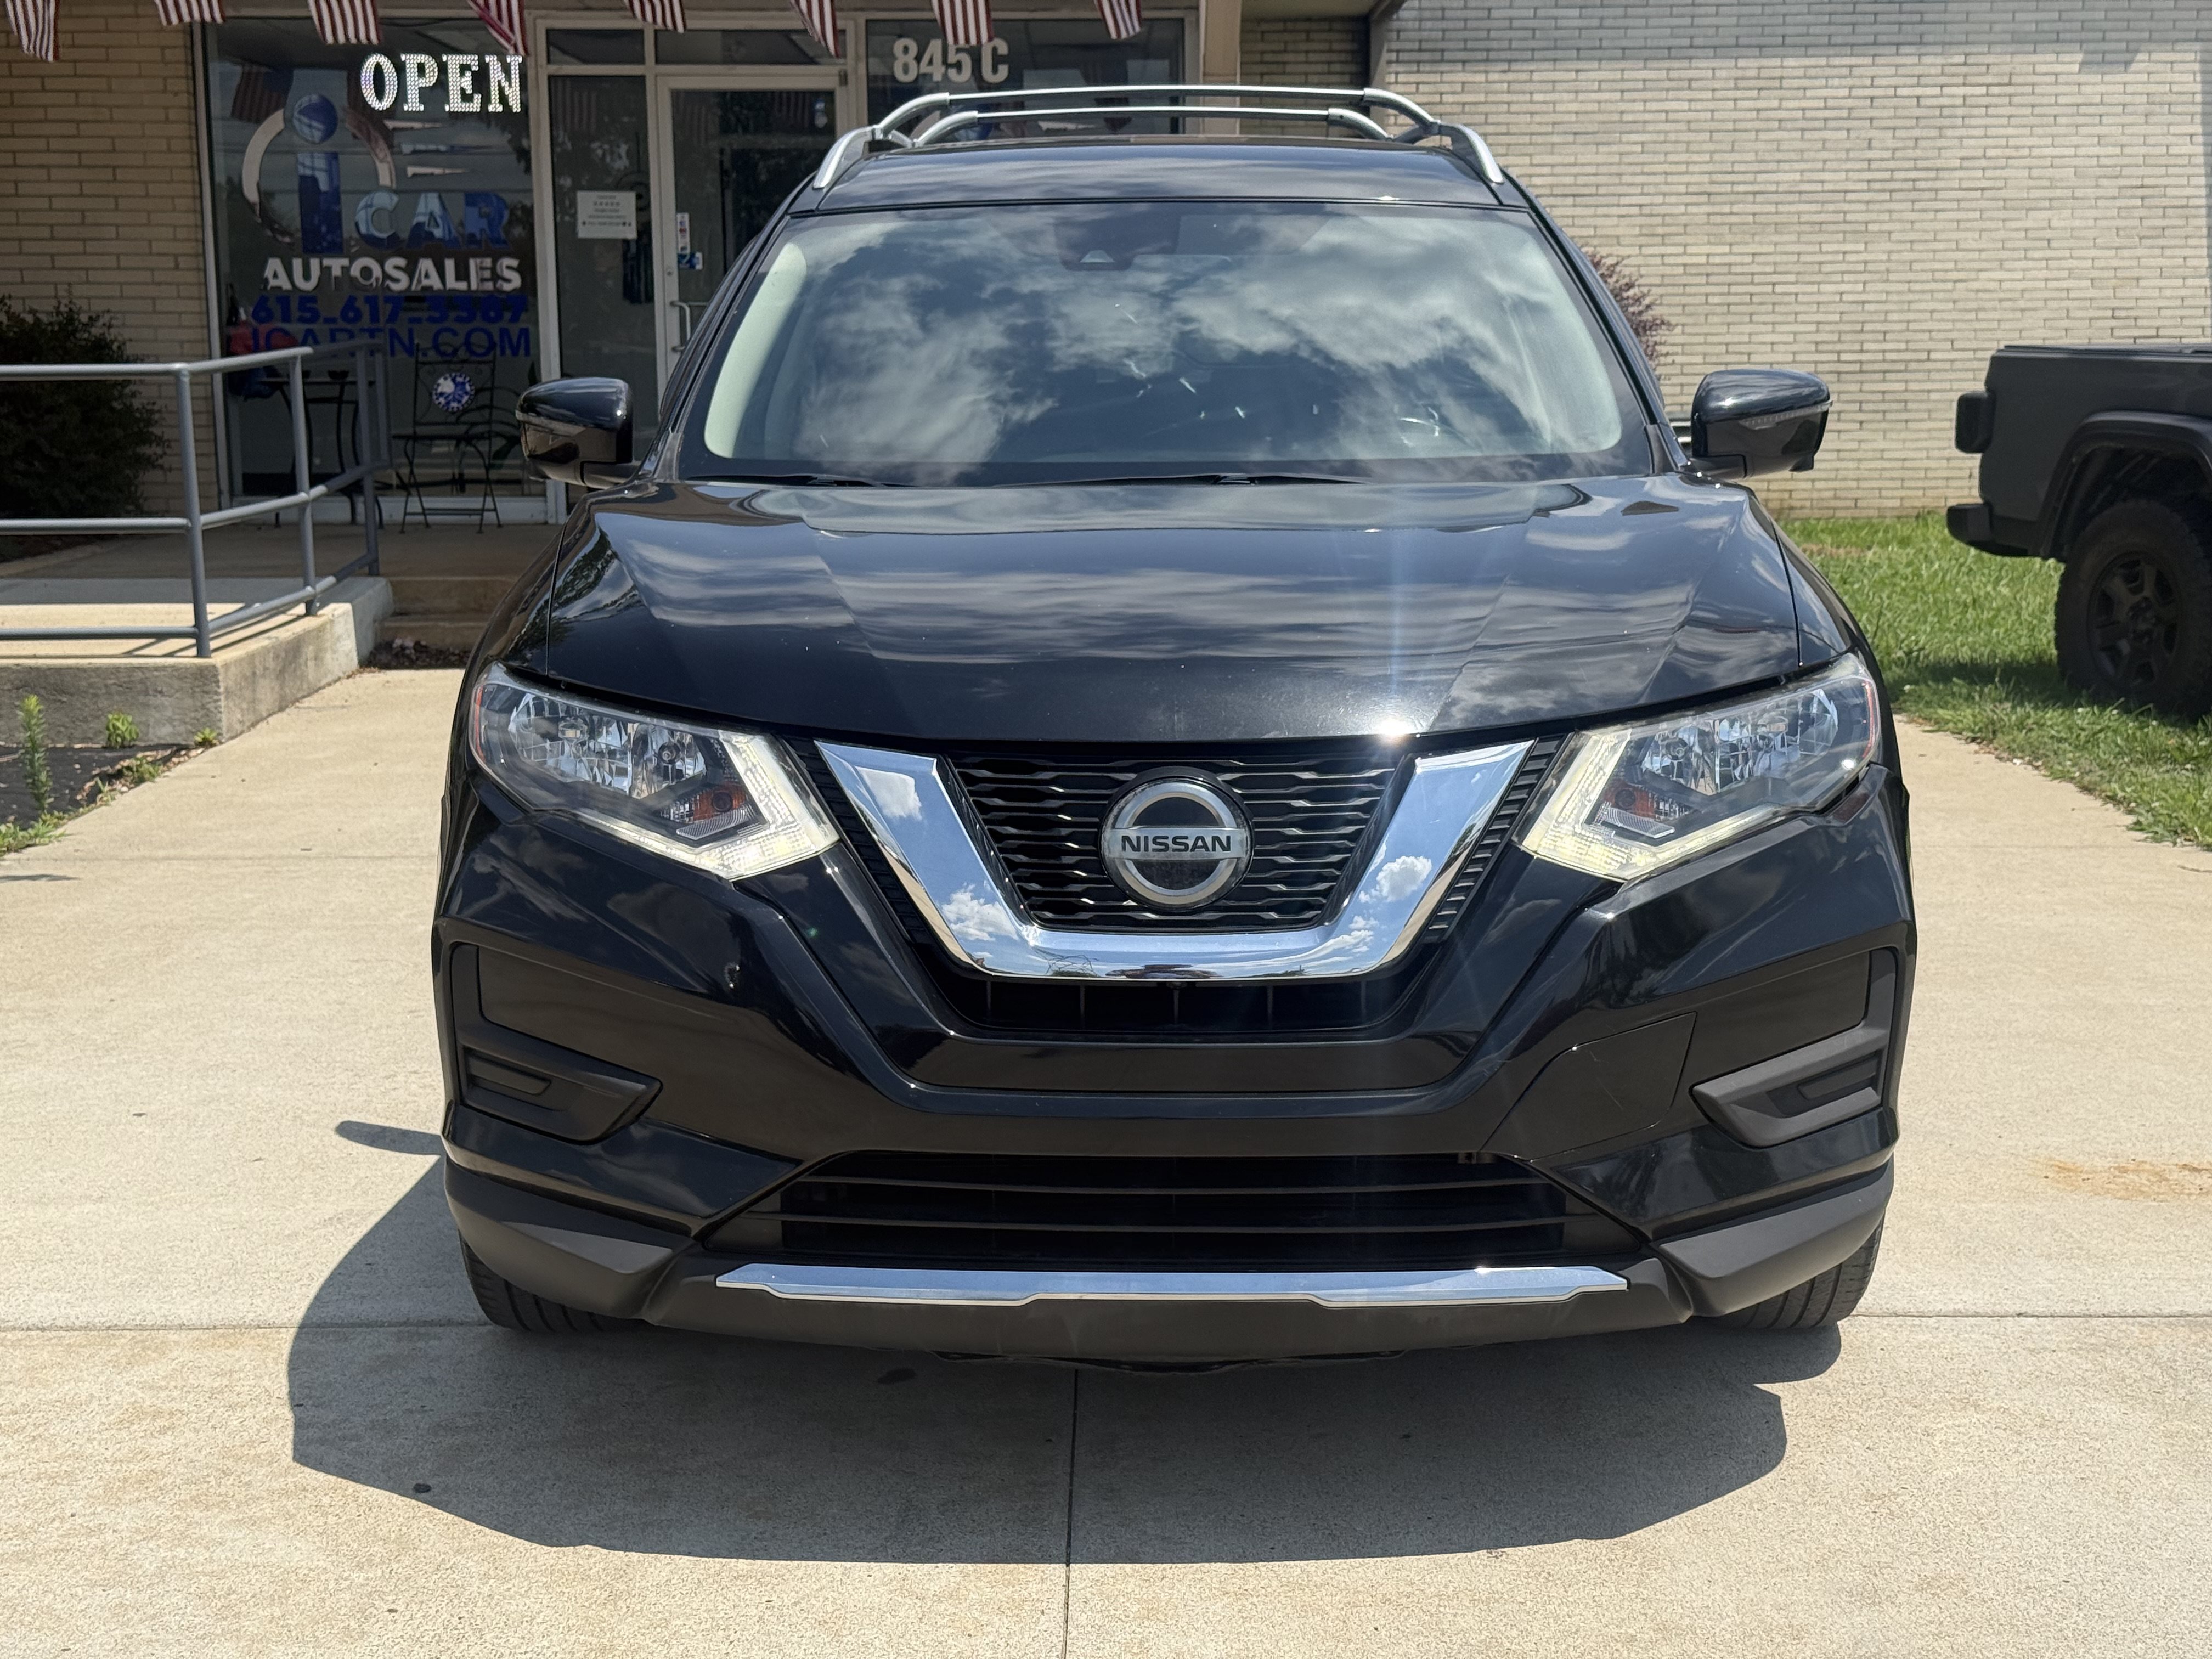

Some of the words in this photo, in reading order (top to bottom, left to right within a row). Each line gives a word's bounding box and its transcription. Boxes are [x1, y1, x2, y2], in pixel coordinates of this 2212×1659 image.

[893, 38, 972, 83] 845
[981, 38, 1009, 83] C
[360, 53, 523, 112] OPEN
[263, 257, 522, 292] AUTOSALES
[1121, 835, 1232, 853] NISSAN
